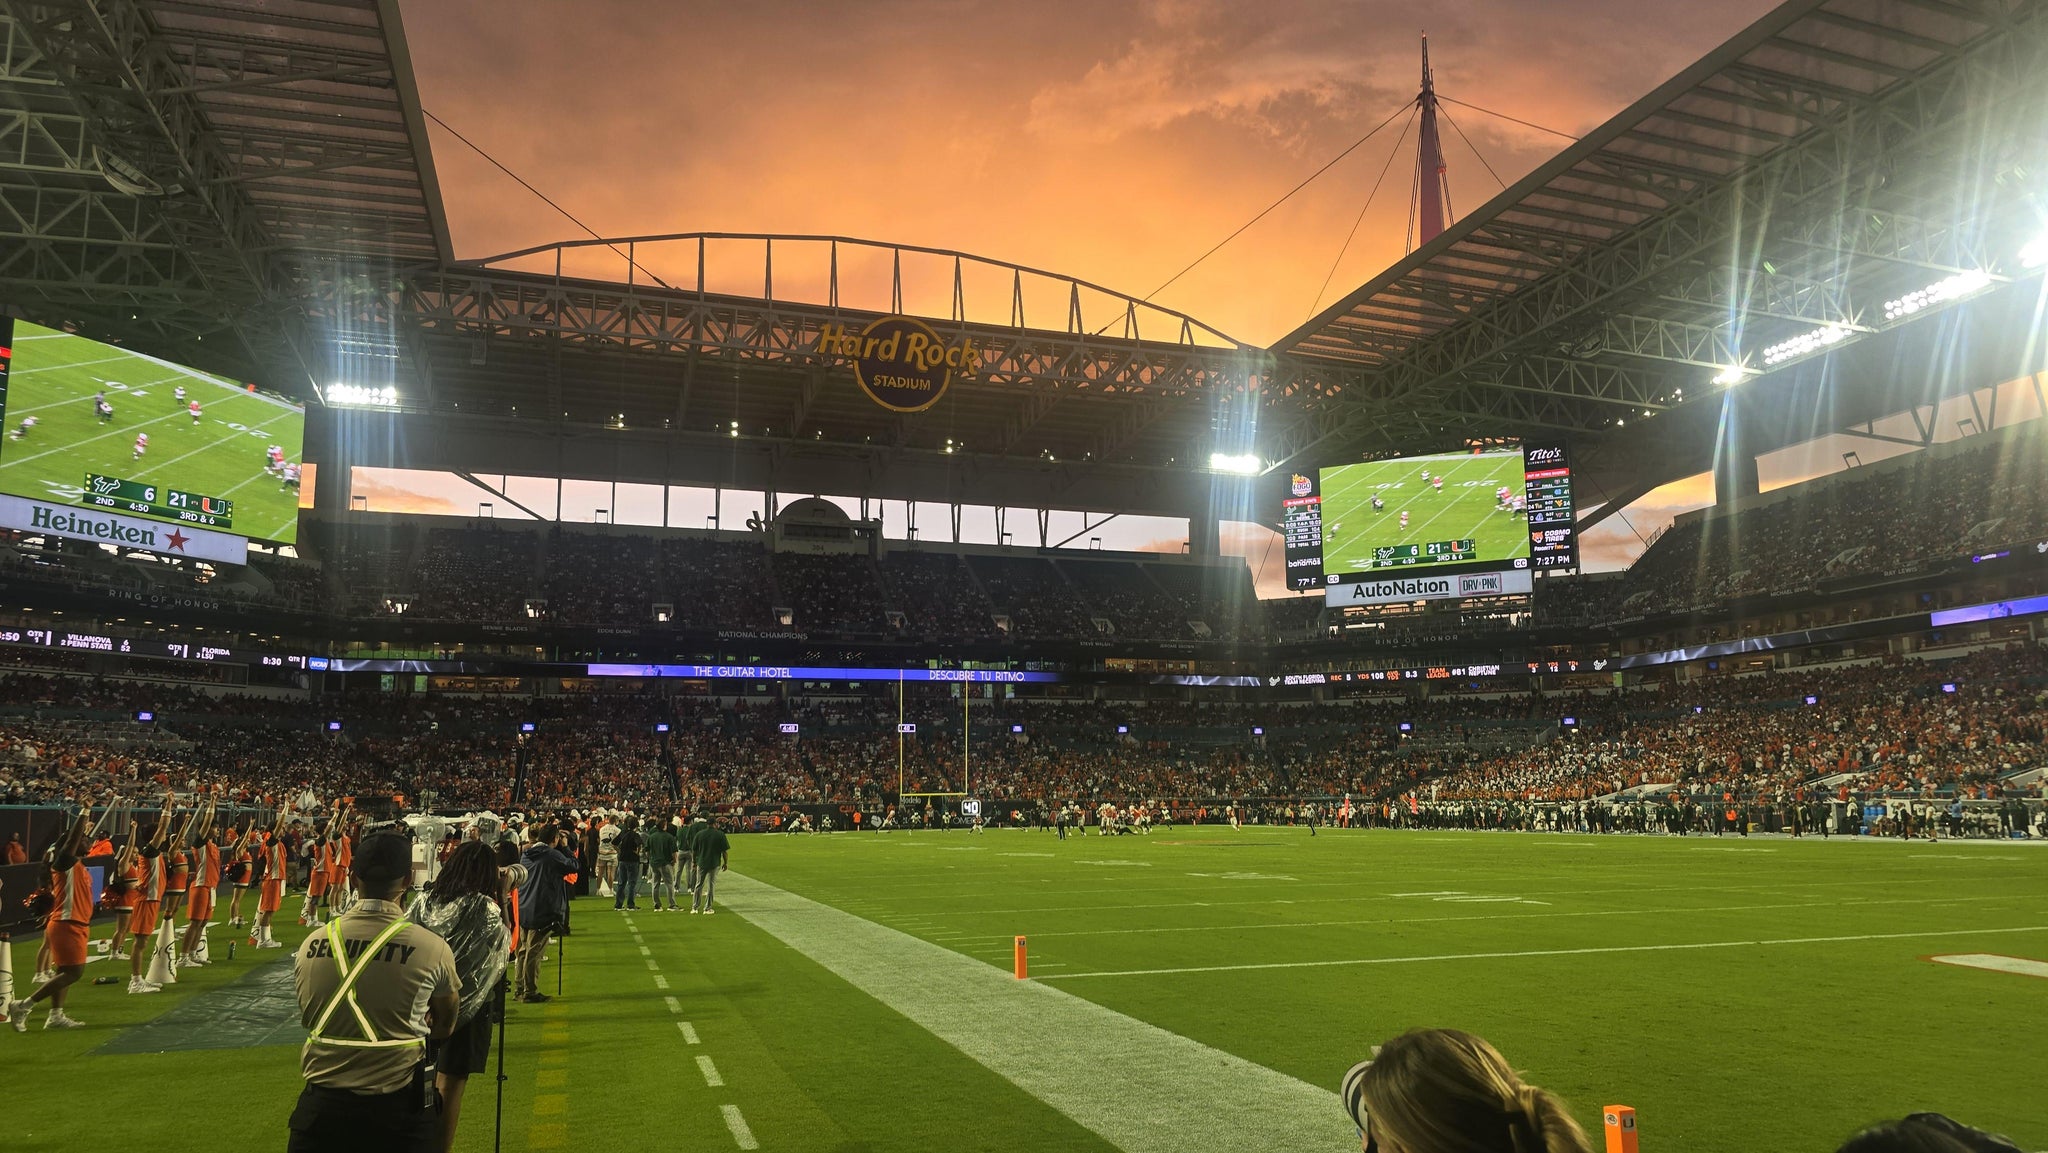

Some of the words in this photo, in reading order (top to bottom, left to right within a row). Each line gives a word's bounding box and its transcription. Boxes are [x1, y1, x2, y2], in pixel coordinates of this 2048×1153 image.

[818, 323, 902, 362] Hard
[904, 332, 980, 375] Rock
[873, 374, 930, 391] STADIUM
[1530, 447, 1562, 460] Tito's
[144, 488, 154, 502] 6
[168, 492, 188, 507] 21
[96, 496, 114, 506] 2ND
[129, 502, 149, 513] 4:50
[180, 512, 198, 522] 3RD
[200, 515, 209, 524] &
[209, 516, 215, 524] 6
[30, 506, 156, 546] Heineken
[1411, 546, 1418, 556] 6
[1428, 544, 1440, 554] 21
[1536, 556, 1554, 566] 7:27
[1558, 555, 1569, 564] PM
[1898, 566, 1917, 574] LEWIS
[1353, 579, 1449, 599] AutoNation
[1463, 580, 1478, 591] DRV
[1482, 578, 1497, 589] PNK
[108, 589, 142, 600] RING
[151, 595, 167, 604] OF
[174, 598, 219, 610] HONOR
[68, 634, 112, 644] VILLANOVA
[760, 631, 808, 640] CHAMPIONS
[202, 647, 230, 656] FLORIDA
[263, 657, 282, 665] 8:30
[693, 666, 713, 677] THE
[718, 666, 755, 677] GUITAR
[760, 667, 792, 678] HOTEL
[930, 670, 975, 681] DESCUBRE
[980, 671, 992, 681] TU
[963, 802, 978, 813] 40
